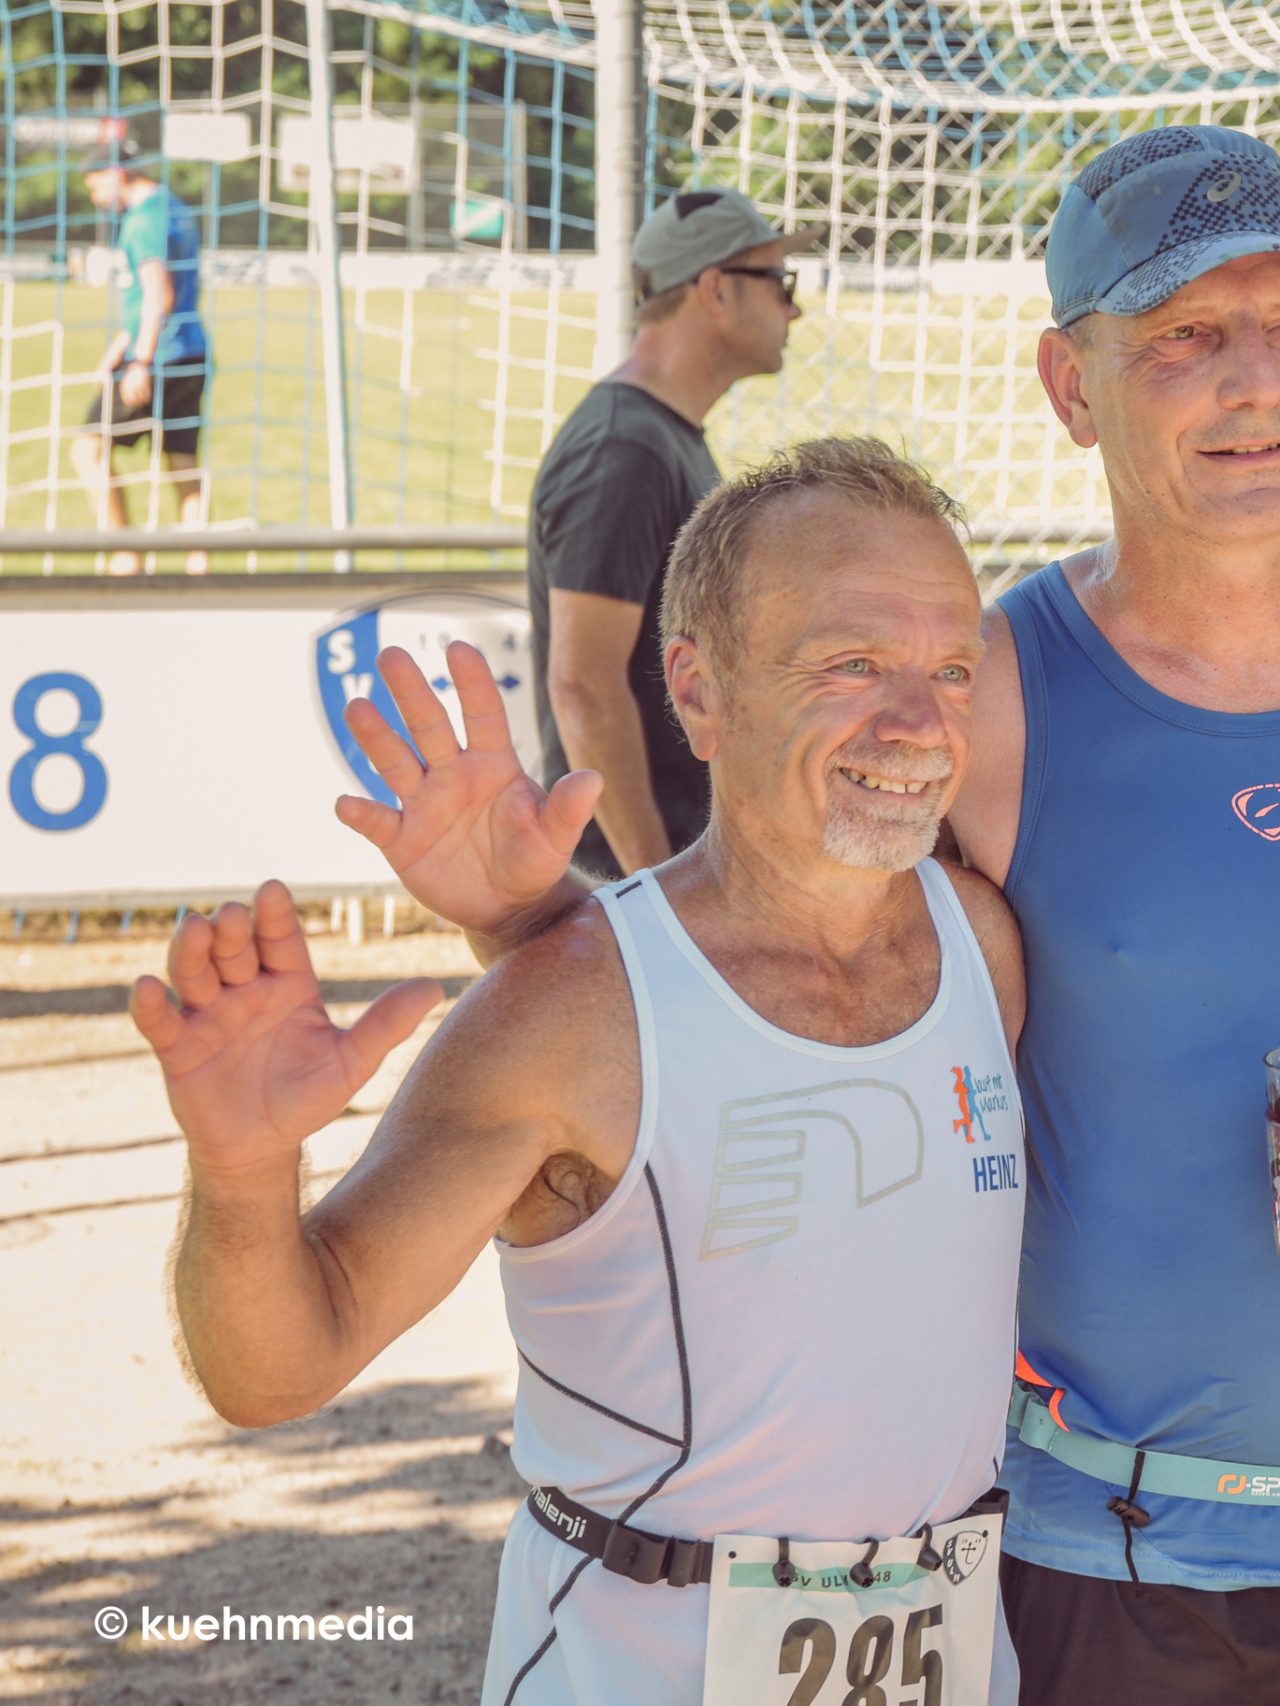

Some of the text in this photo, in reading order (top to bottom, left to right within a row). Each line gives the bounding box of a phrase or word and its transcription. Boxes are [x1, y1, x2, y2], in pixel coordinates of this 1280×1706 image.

[9, 671, 110, 832] 8
[972, 1153, 1019, 1193] HEINZ
[778, 1603, 944, 1706] 285
